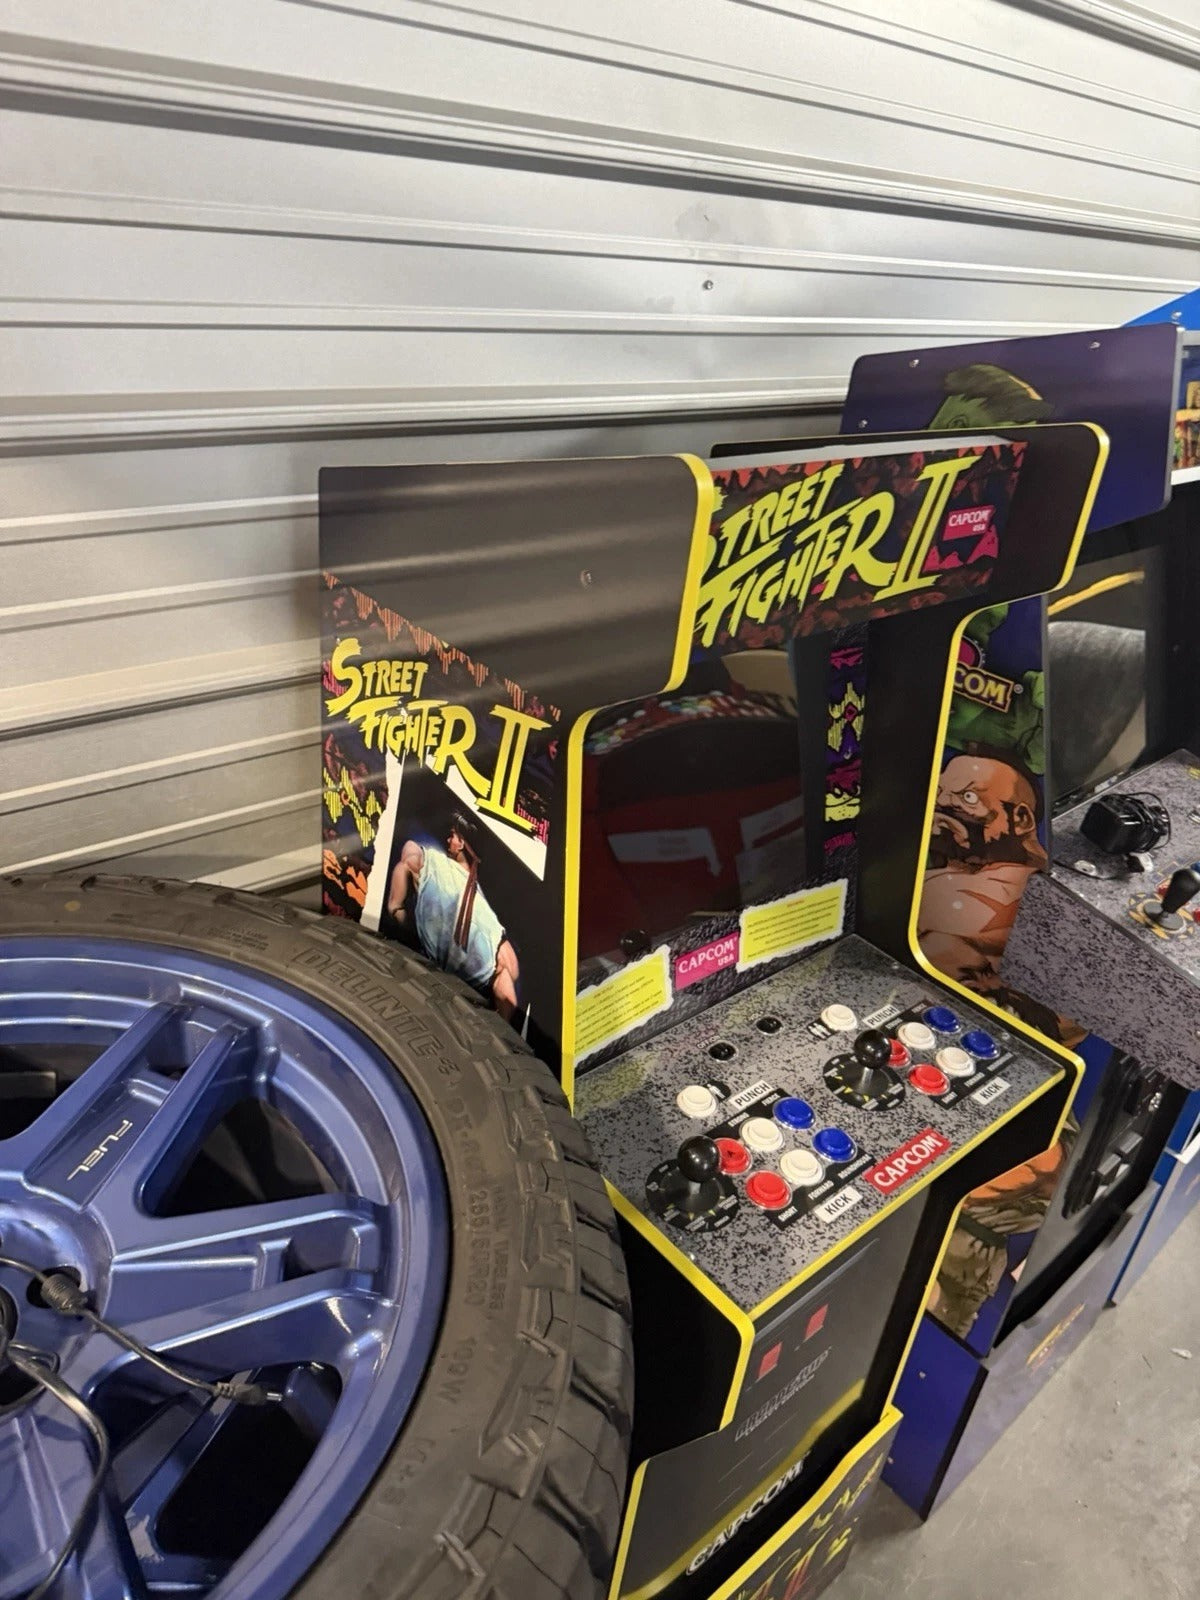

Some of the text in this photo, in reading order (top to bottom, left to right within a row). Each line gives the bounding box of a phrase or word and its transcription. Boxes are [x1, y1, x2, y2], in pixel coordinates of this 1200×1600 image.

[949, 509, 992, 527] CAPCOM
[694, 456, 982, 647] FIGHTER II
[325, 638, 428, 716] STREET
[954, 667, 1007, 705] COM
[347, 696, 552, 832] FIGHTER II
[679, 939, 735, 974] CAPCOM
[718, 953, 735, 966] USA
[291, 949, 445, 1057] DELINTE
[867, 1006, 897, 1025] PUNCH
[735, 1083, 771, 1106] PUNCH
[980, 1082, 1003, 1100] KICK
[67, 1119, 133, 1181] FUEL
[874, 1134, 943, 1187] CAPCOM
[825, 1193, 853, 1215] KICK
[686, 1459, 804, 1575] CAPCOM
